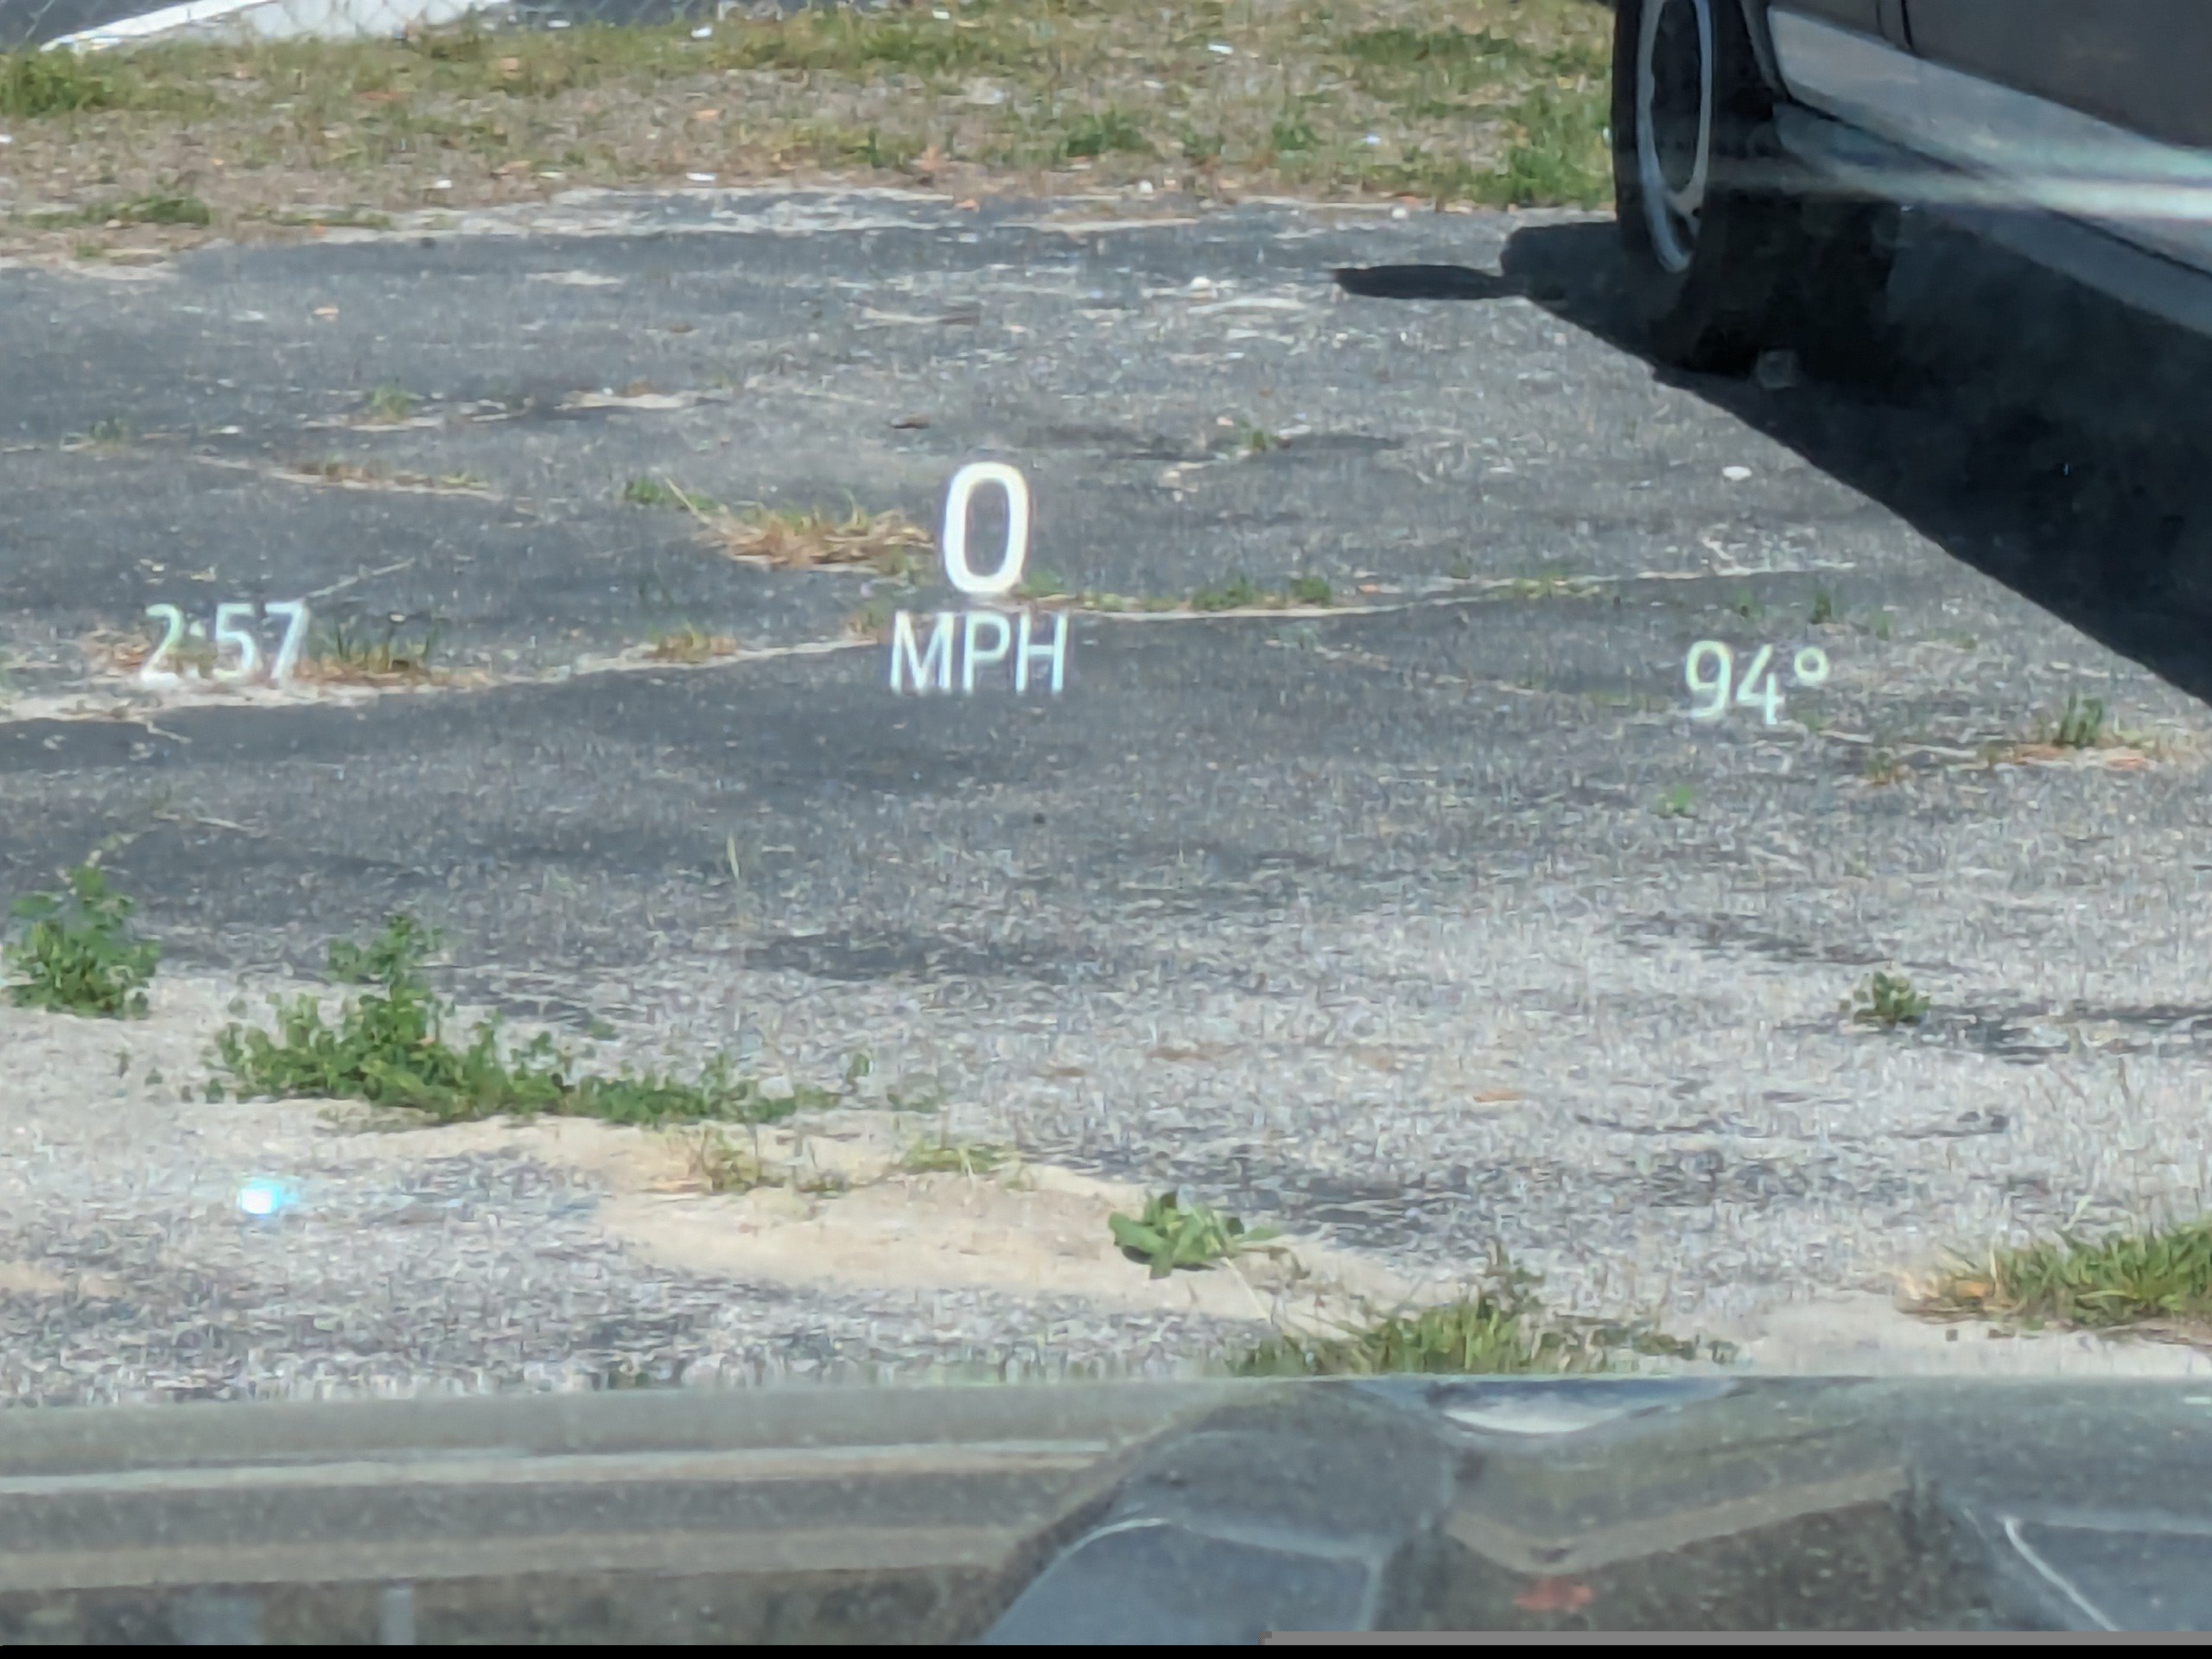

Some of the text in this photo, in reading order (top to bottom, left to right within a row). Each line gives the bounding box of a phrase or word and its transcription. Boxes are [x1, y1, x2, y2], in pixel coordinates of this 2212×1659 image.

[943, 461, 1030, 595] 0
[138, 601, 309, 686] 2:57
[890, 609, 1069, 695] MPH
[1686, 640, 1829, 725] 94°
